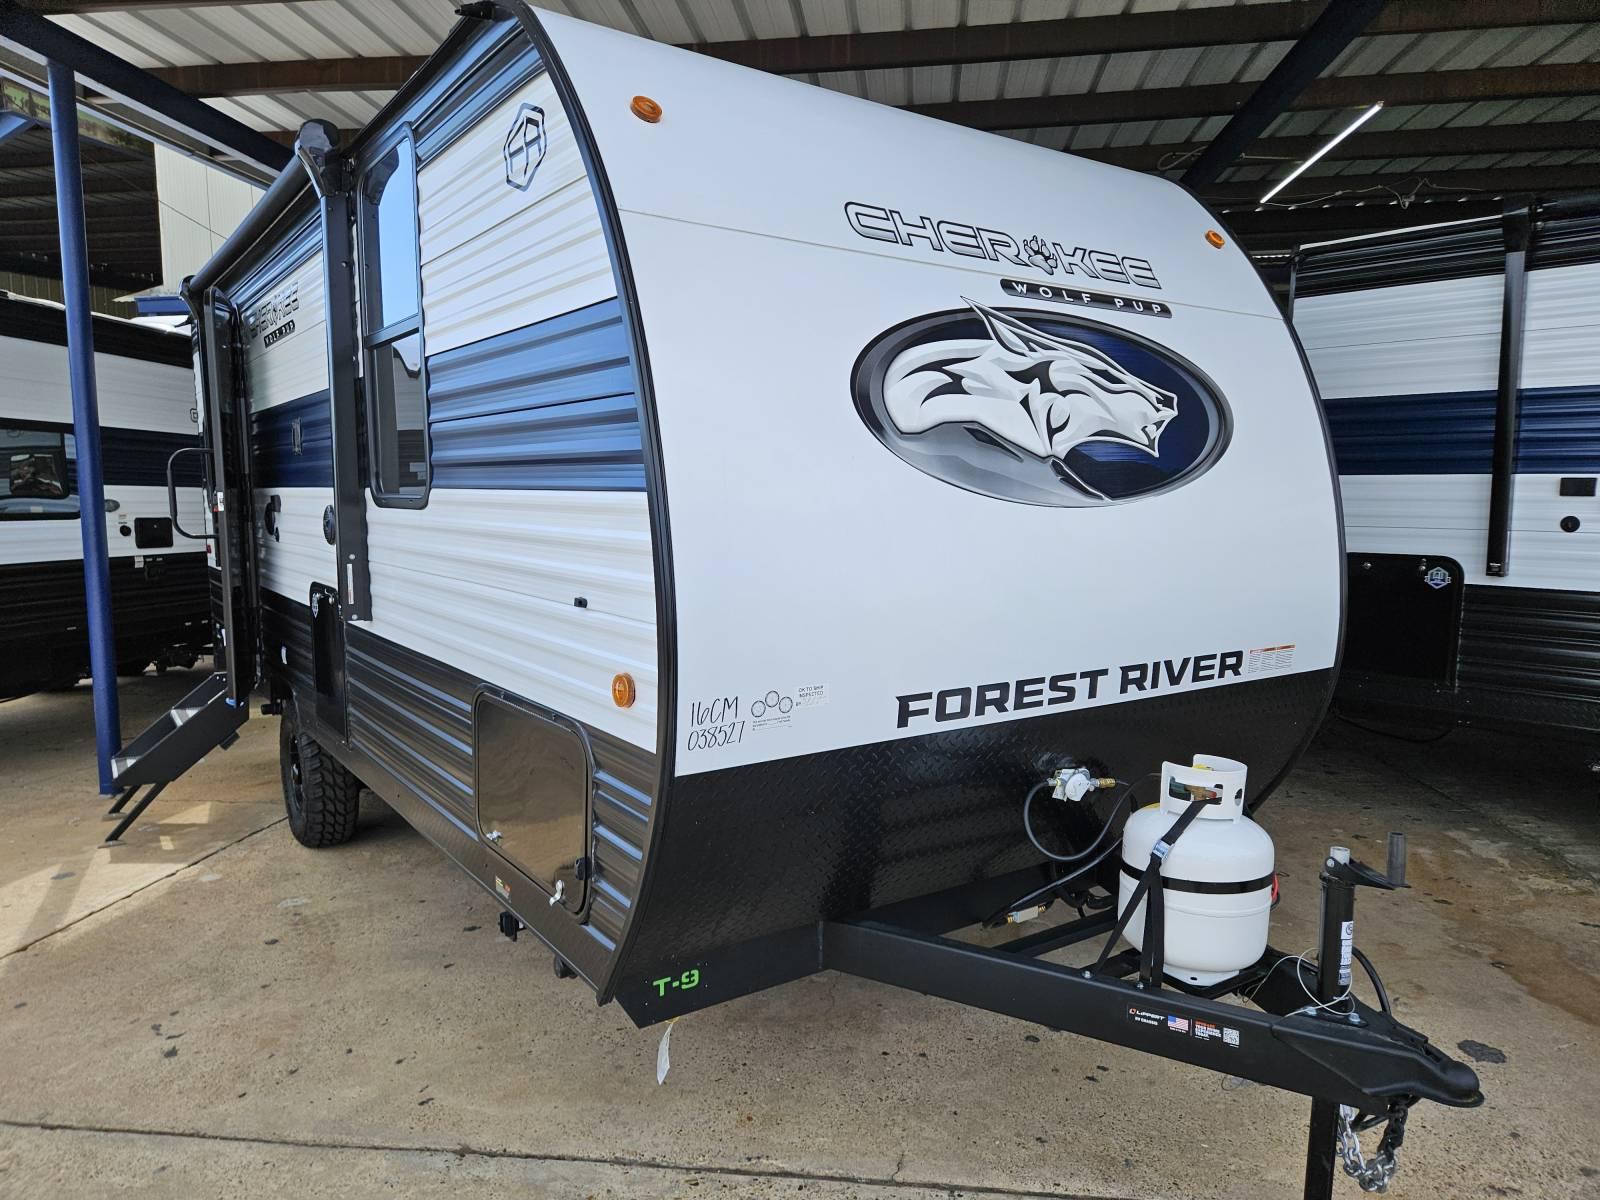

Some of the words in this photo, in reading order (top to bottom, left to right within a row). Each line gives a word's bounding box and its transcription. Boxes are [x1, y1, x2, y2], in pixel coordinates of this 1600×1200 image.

[1012, 281, 1092, 305] WOLF
[1114, 297, 1162, 315] PUP
[895, 668, 1109, 729] FOREST
[1119, 650, 1244, 695] RIVER
[691, 696, 739, 728] 16CM
[687, 720, 746, 751] 038527
[652, 969, 700, 997] T-9
